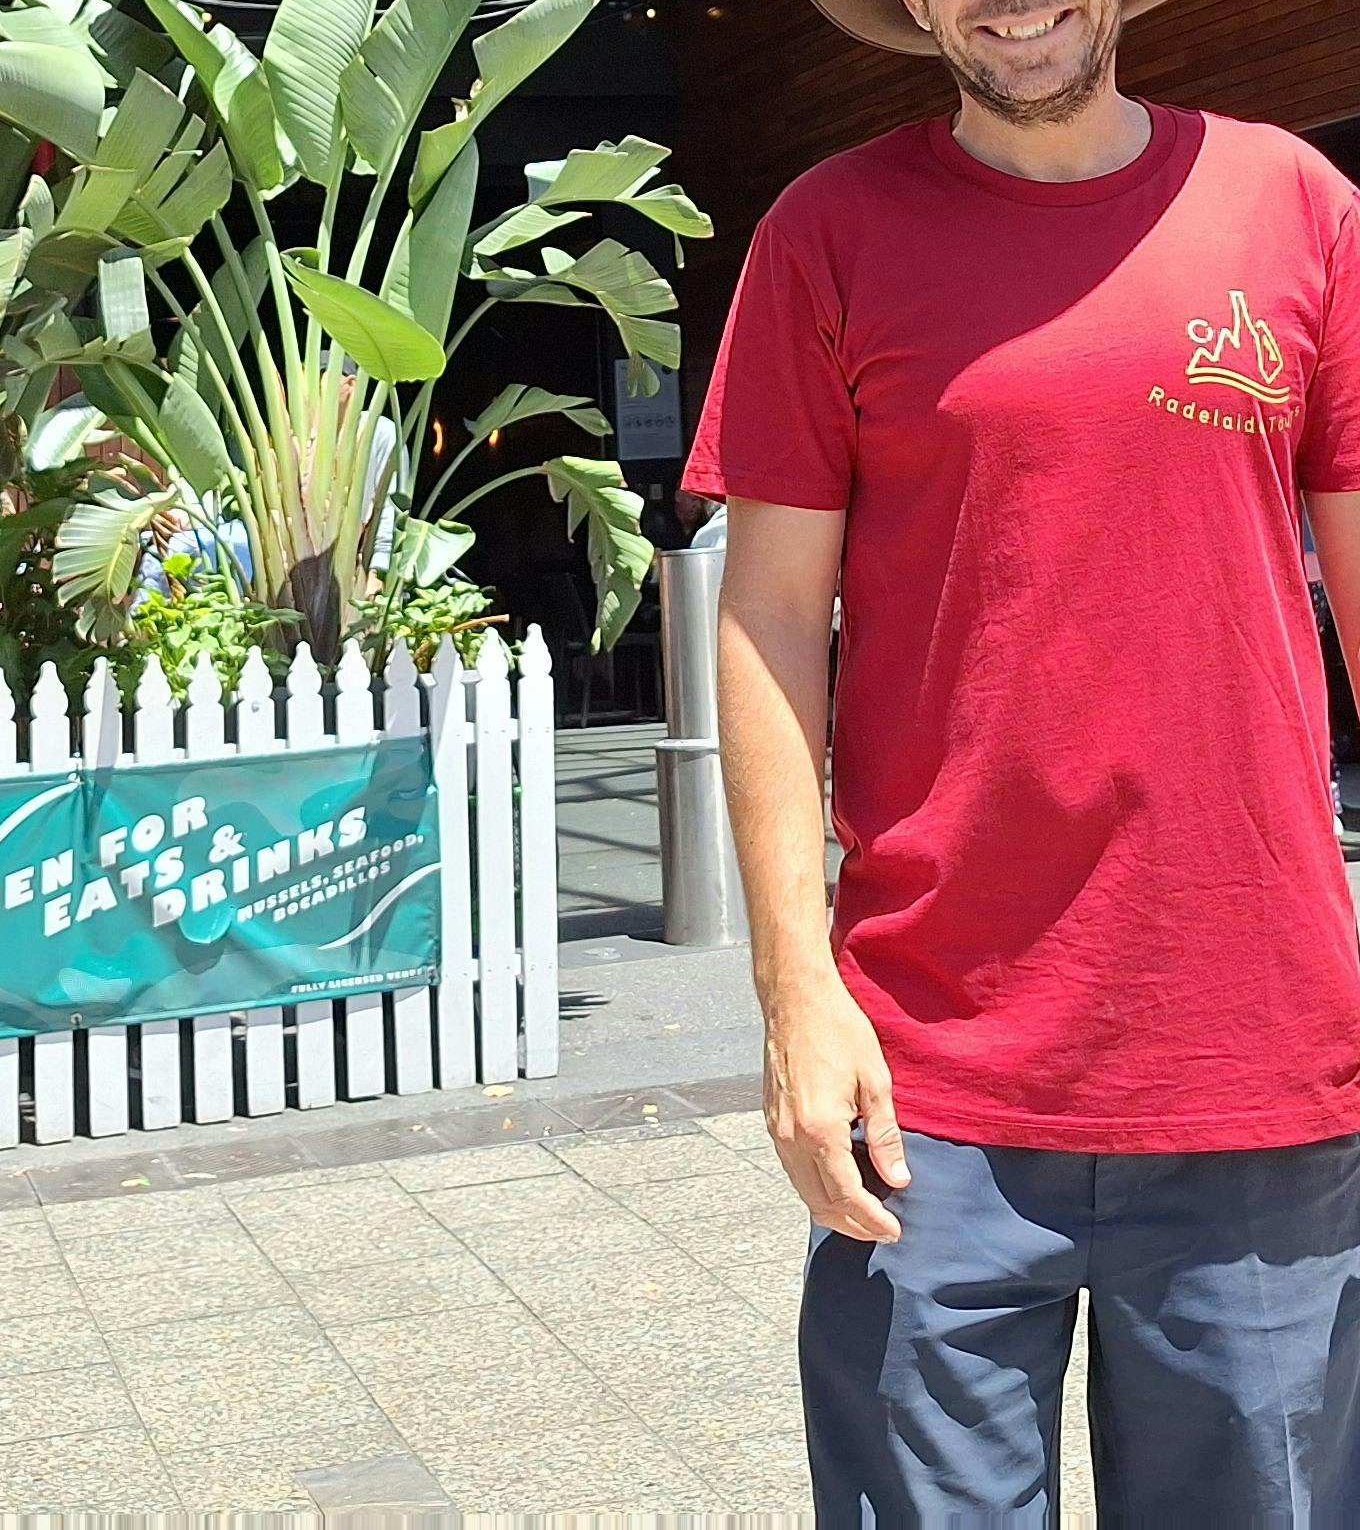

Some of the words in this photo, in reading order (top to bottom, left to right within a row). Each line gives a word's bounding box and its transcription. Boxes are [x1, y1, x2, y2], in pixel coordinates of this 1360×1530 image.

[99, 796, 208, 868] FOR
[152, 806, 368, 928] DRINKS
[43, 846, 184, 937] EATS
[208, 824, 246, 864] &
[273, 861, 391, 923] BOCADILLOS
